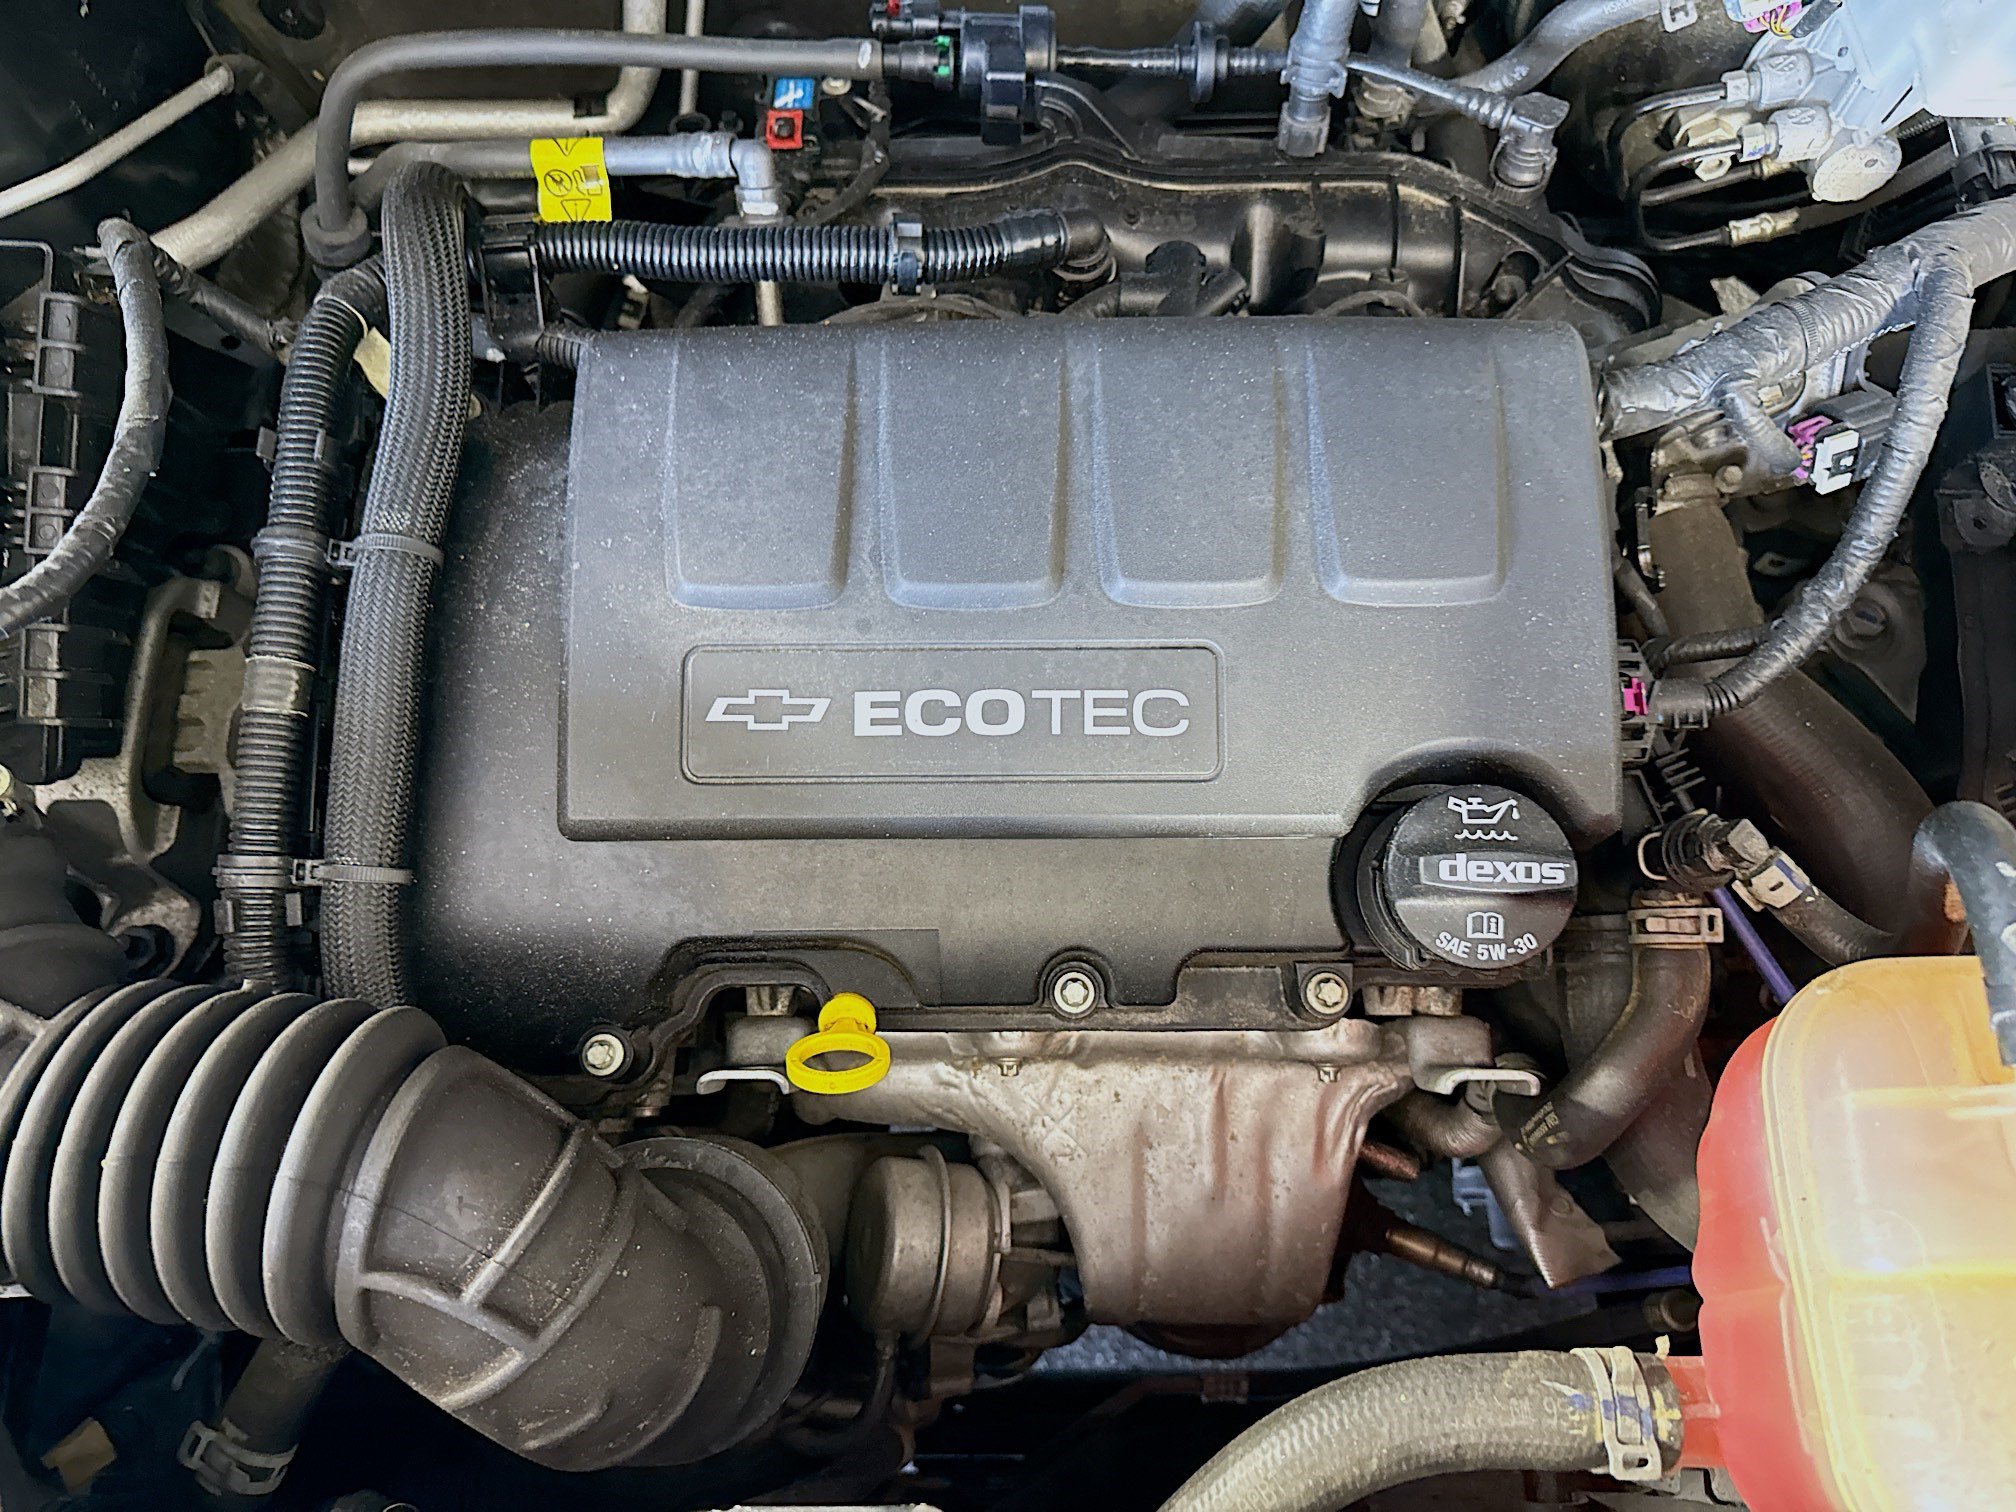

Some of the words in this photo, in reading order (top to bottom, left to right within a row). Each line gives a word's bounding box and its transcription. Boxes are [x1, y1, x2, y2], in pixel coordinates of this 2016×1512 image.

[854, 688, 1190, 737] ECOTEC
[1438, 853, 1566, 885] dexos
[1435, 931, 1472, 959] SAE
[1477, 932, 1538, 961] 5W-30
